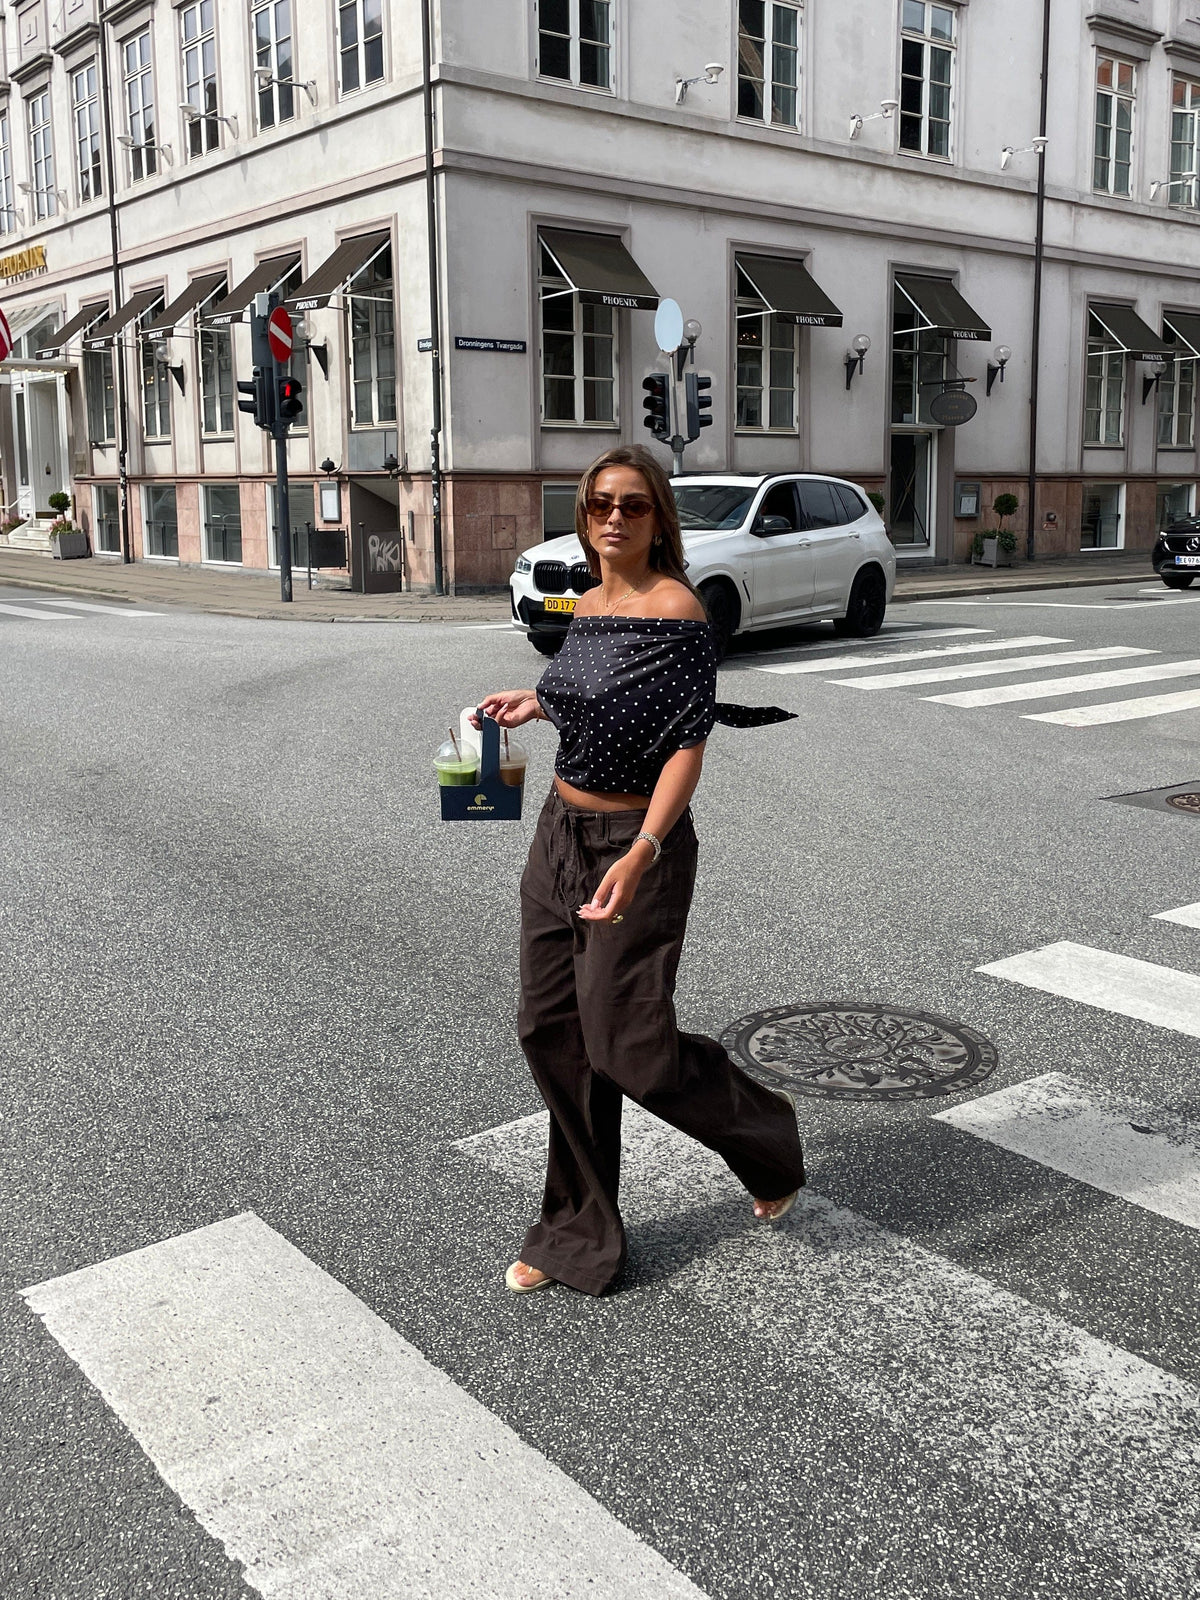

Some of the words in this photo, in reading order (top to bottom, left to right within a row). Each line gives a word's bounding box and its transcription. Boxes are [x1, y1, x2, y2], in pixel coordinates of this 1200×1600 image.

[602, 295, 638, 307] PHOENIX
[795, 315, 825, 325] PHOENIX
[458, 339, 494, 349] Dronningens
[547, 600, 558, 609] DD
[560, 600, 570, 610] 17
